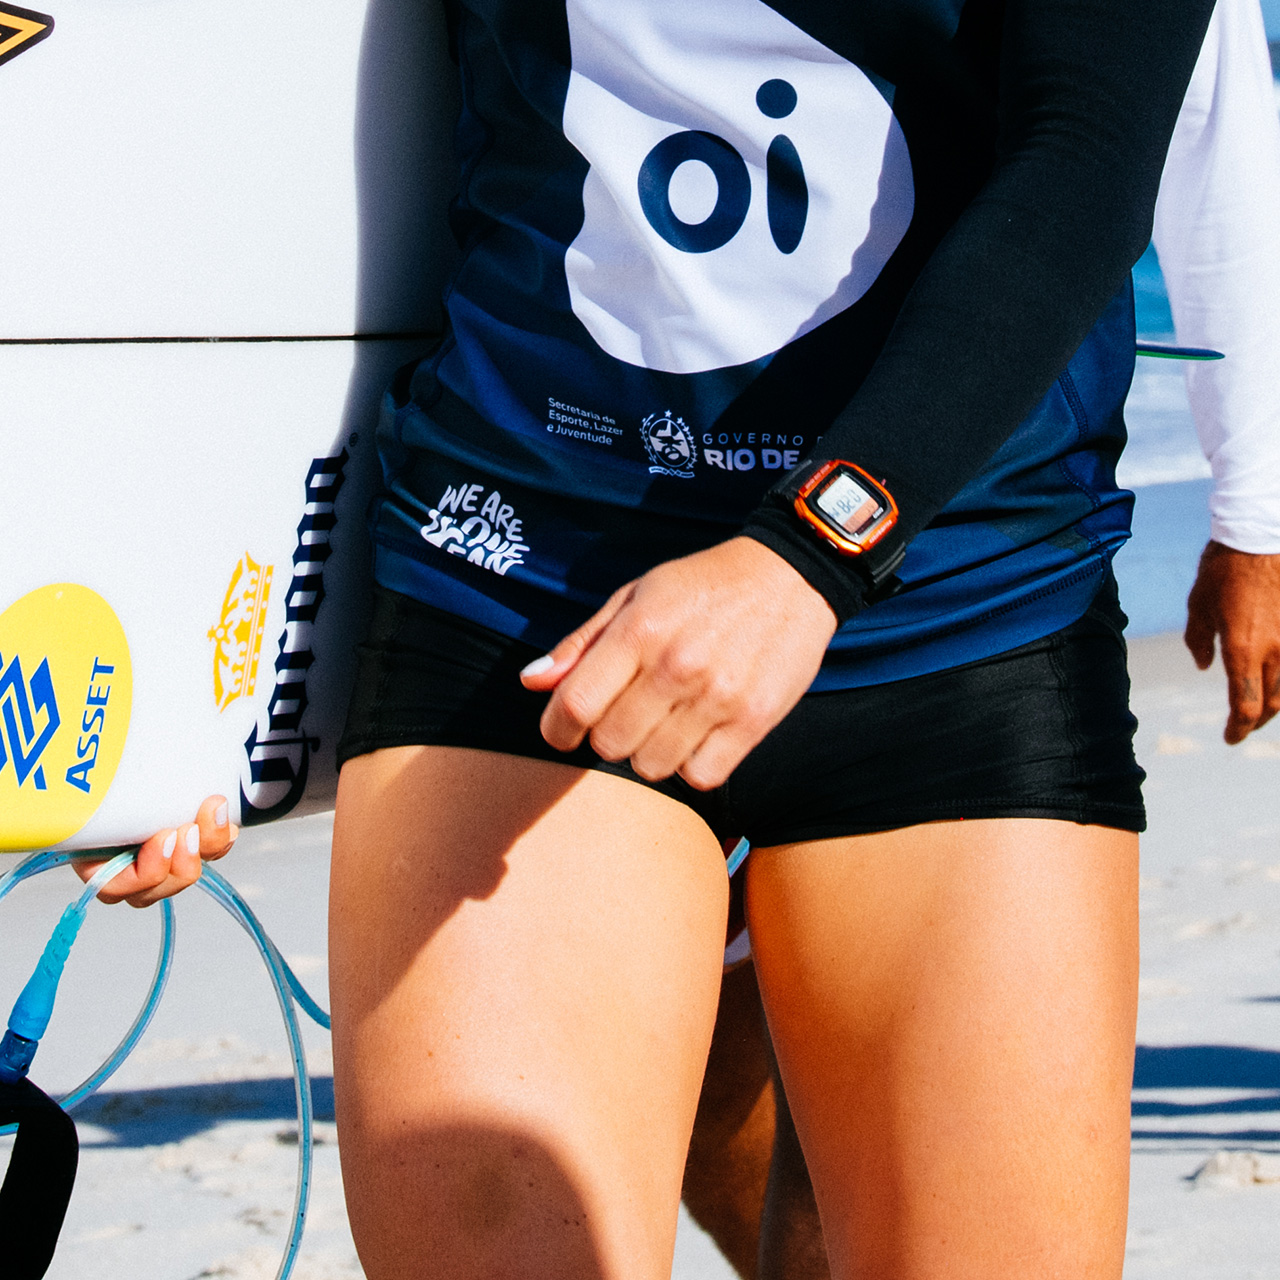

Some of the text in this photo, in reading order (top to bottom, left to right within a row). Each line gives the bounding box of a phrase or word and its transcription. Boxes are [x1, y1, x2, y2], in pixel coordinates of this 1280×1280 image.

[637, 78, 809, 255] oi
[548, 397, 616, 425] Secretaria de
[548, 410, 623, 436] Esporte, Lazer
[546, 424, 613, 446] e Juventude
[702, 432, 804, 447] GOVERNO
[703, 448, 800, 471] RIO DE
[437, 483, 524, 542] WE ARE
[238, 445, 349, 826] Corona
[65, 656, 115, 793] ASSET
